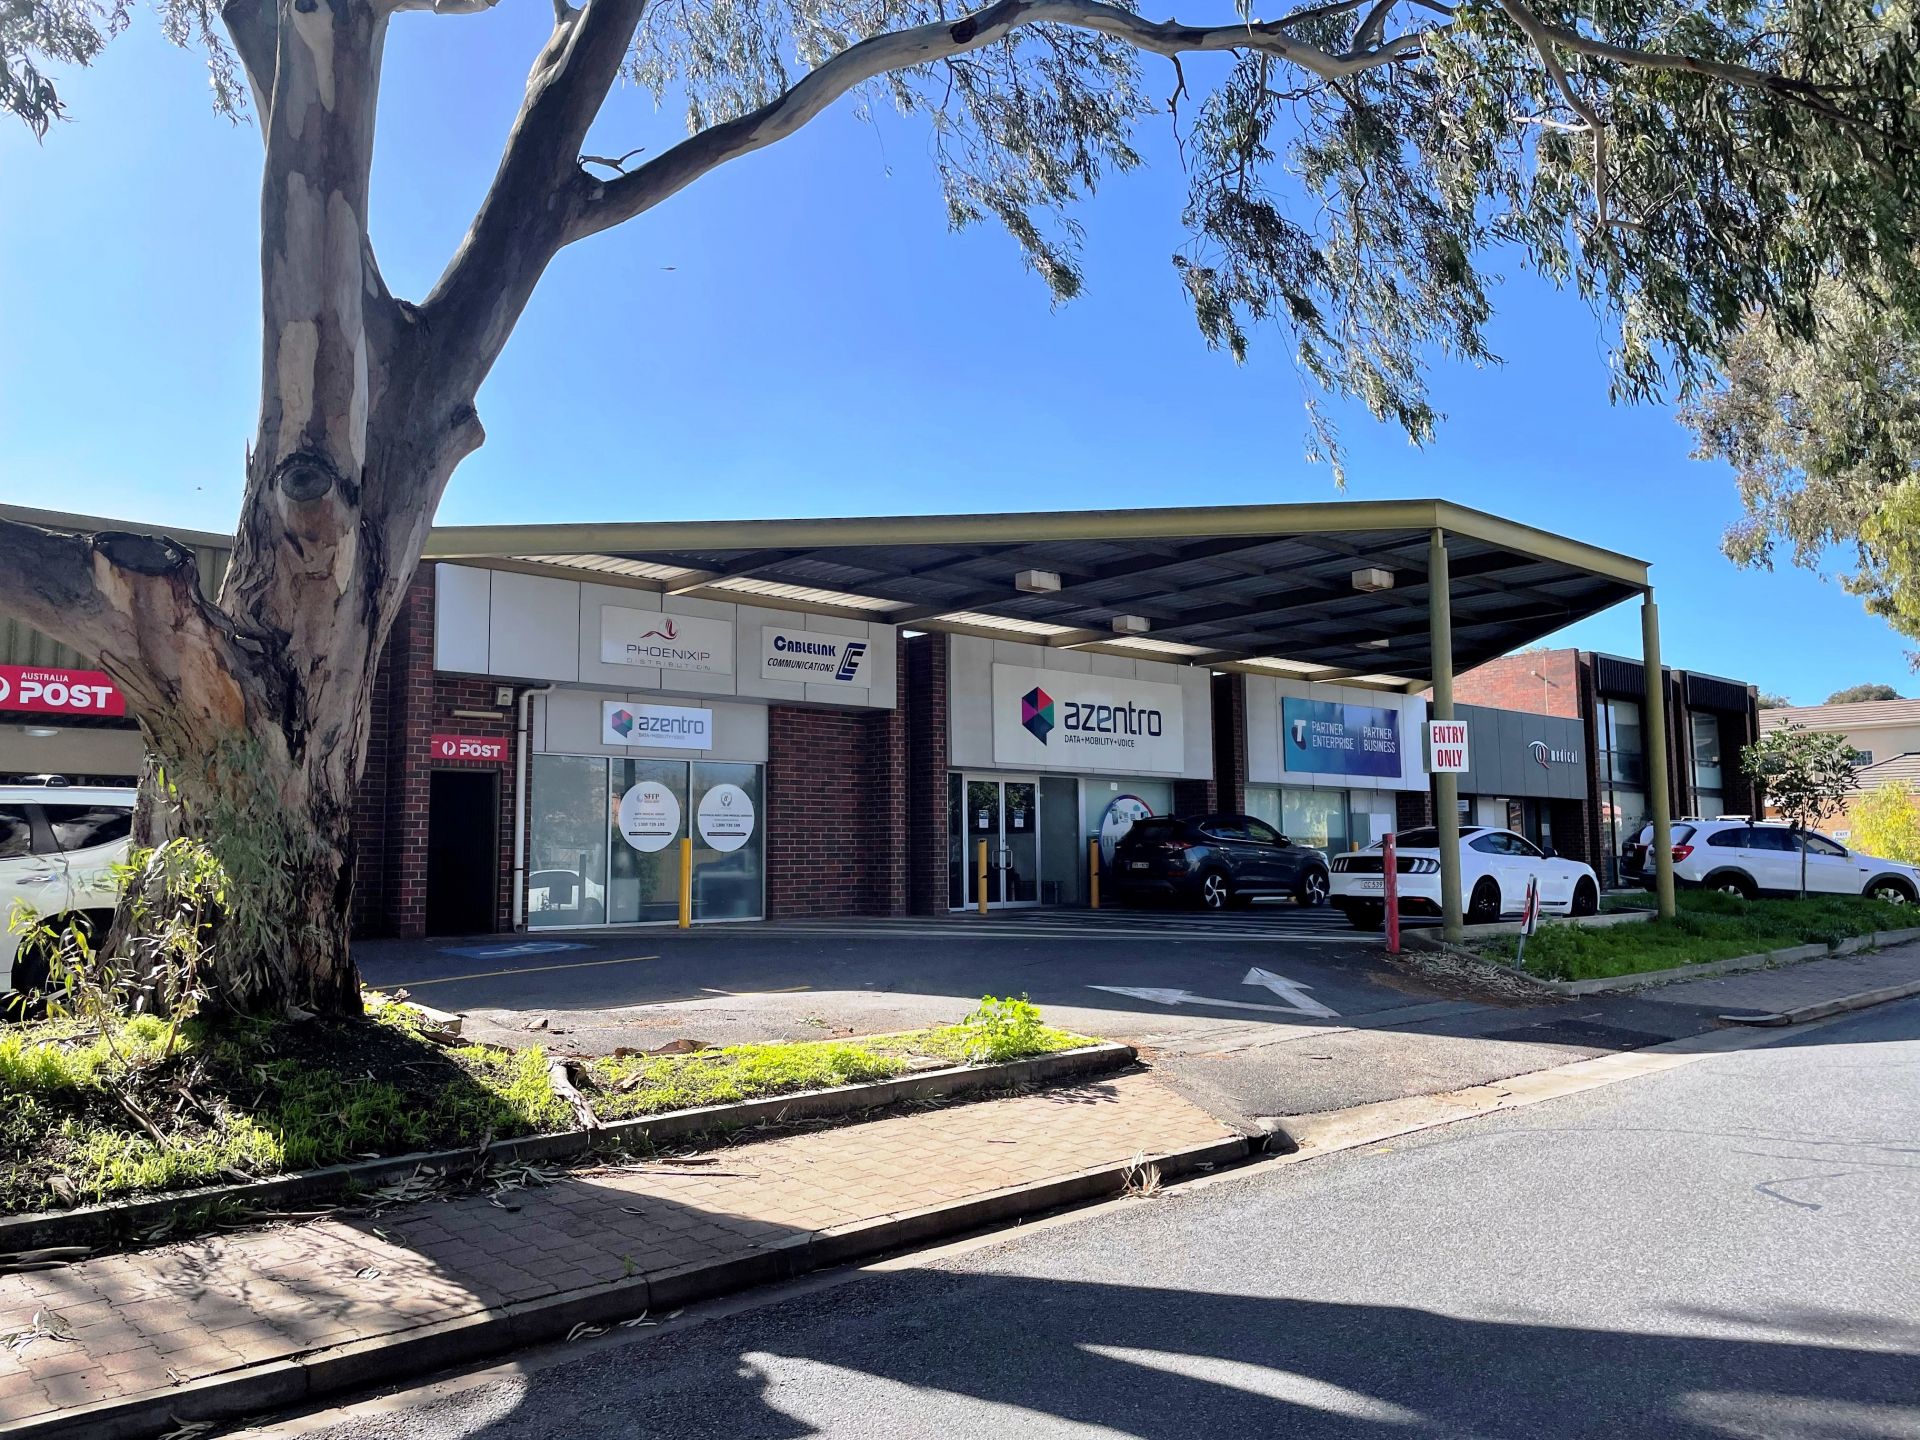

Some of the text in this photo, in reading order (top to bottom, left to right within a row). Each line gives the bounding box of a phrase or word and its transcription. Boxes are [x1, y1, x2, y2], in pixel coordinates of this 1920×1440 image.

[767, 658, 835, 673] COMMUNICATIONS
[21, 672, 69, 682] AUSTRALIA
[20, 681, 113, 708] POST
[638, 715, 704, 734] azentro
[1064, 701, 1162, 736] azentro
[1311, 721, 1344, 736] PARTNER
[1362, 726, 1393, 740] PARTNER
[1432, 726, 1464, 743] ENTRY
[459, 743, 501, 757] POST
[1312, 735, 1355, 750] ENTERPRISE
[1363, 740, 1396, 753] BUSINESS
[1437, 749, 1462, 768] ONLY
[1551, 749, 1578, 763] medical
